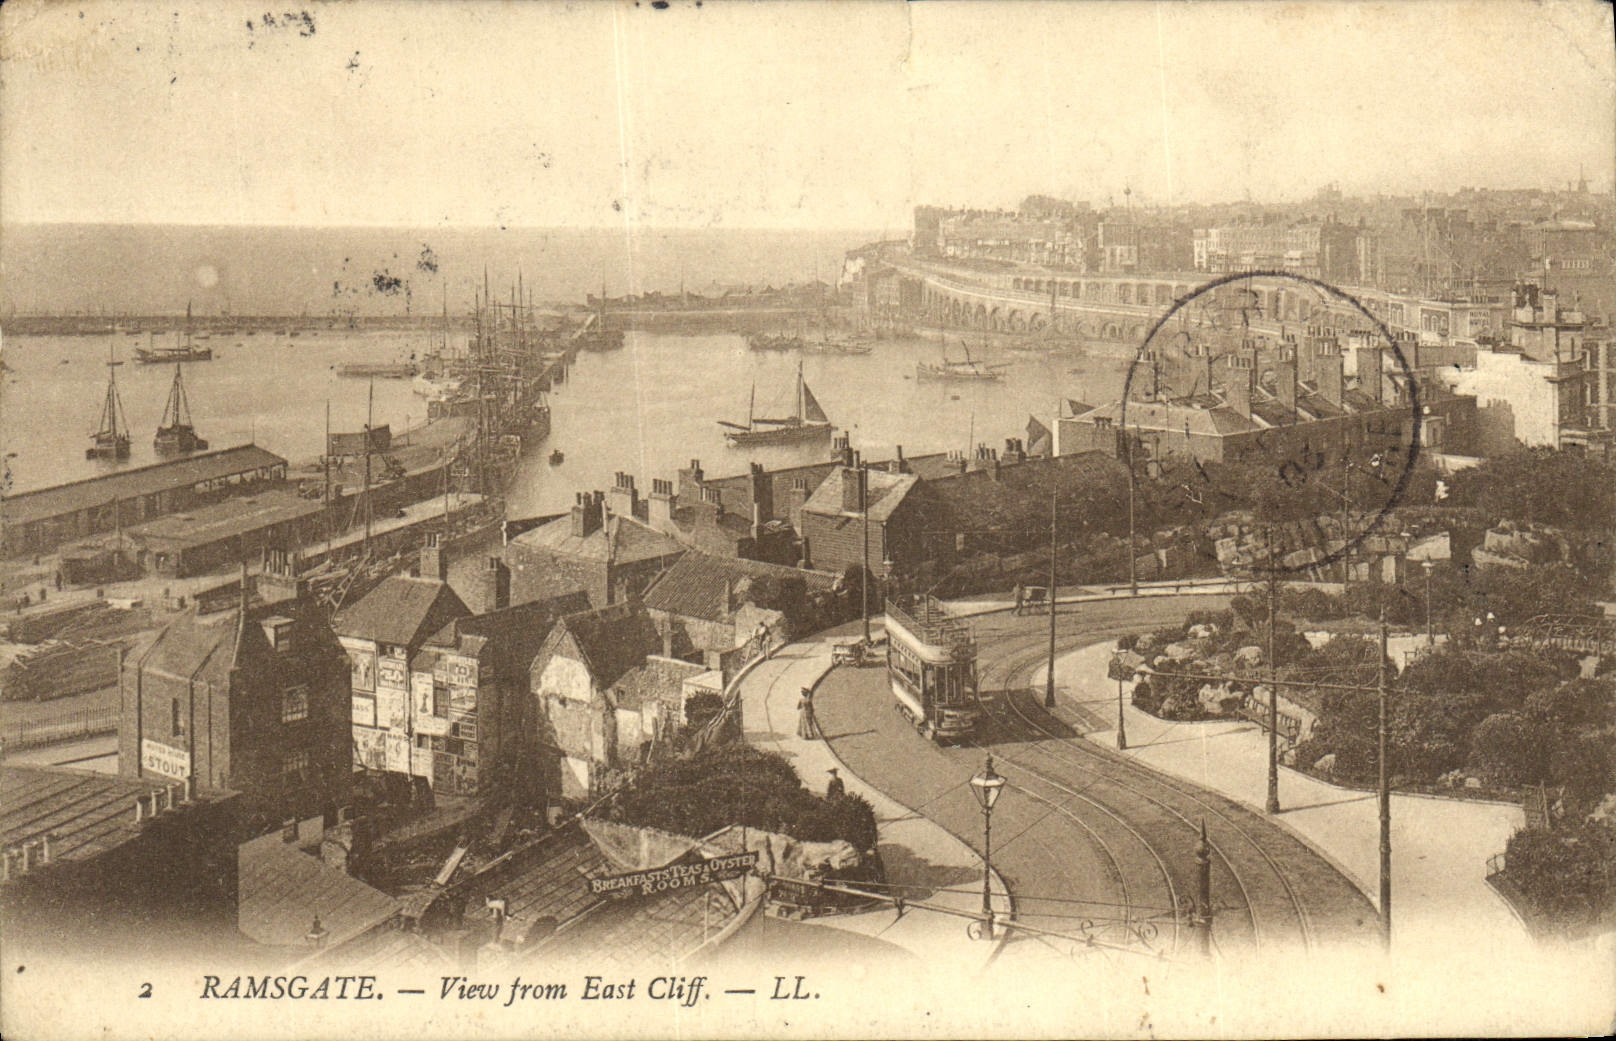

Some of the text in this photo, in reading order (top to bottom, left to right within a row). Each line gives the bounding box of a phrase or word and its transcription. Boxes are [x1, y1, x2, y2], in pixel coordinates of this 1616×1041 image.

[149, 755, 185, 776] STOUT
[671, 863, 703, 878] TEAS
[710, 855, 756, 872] OYSTER
